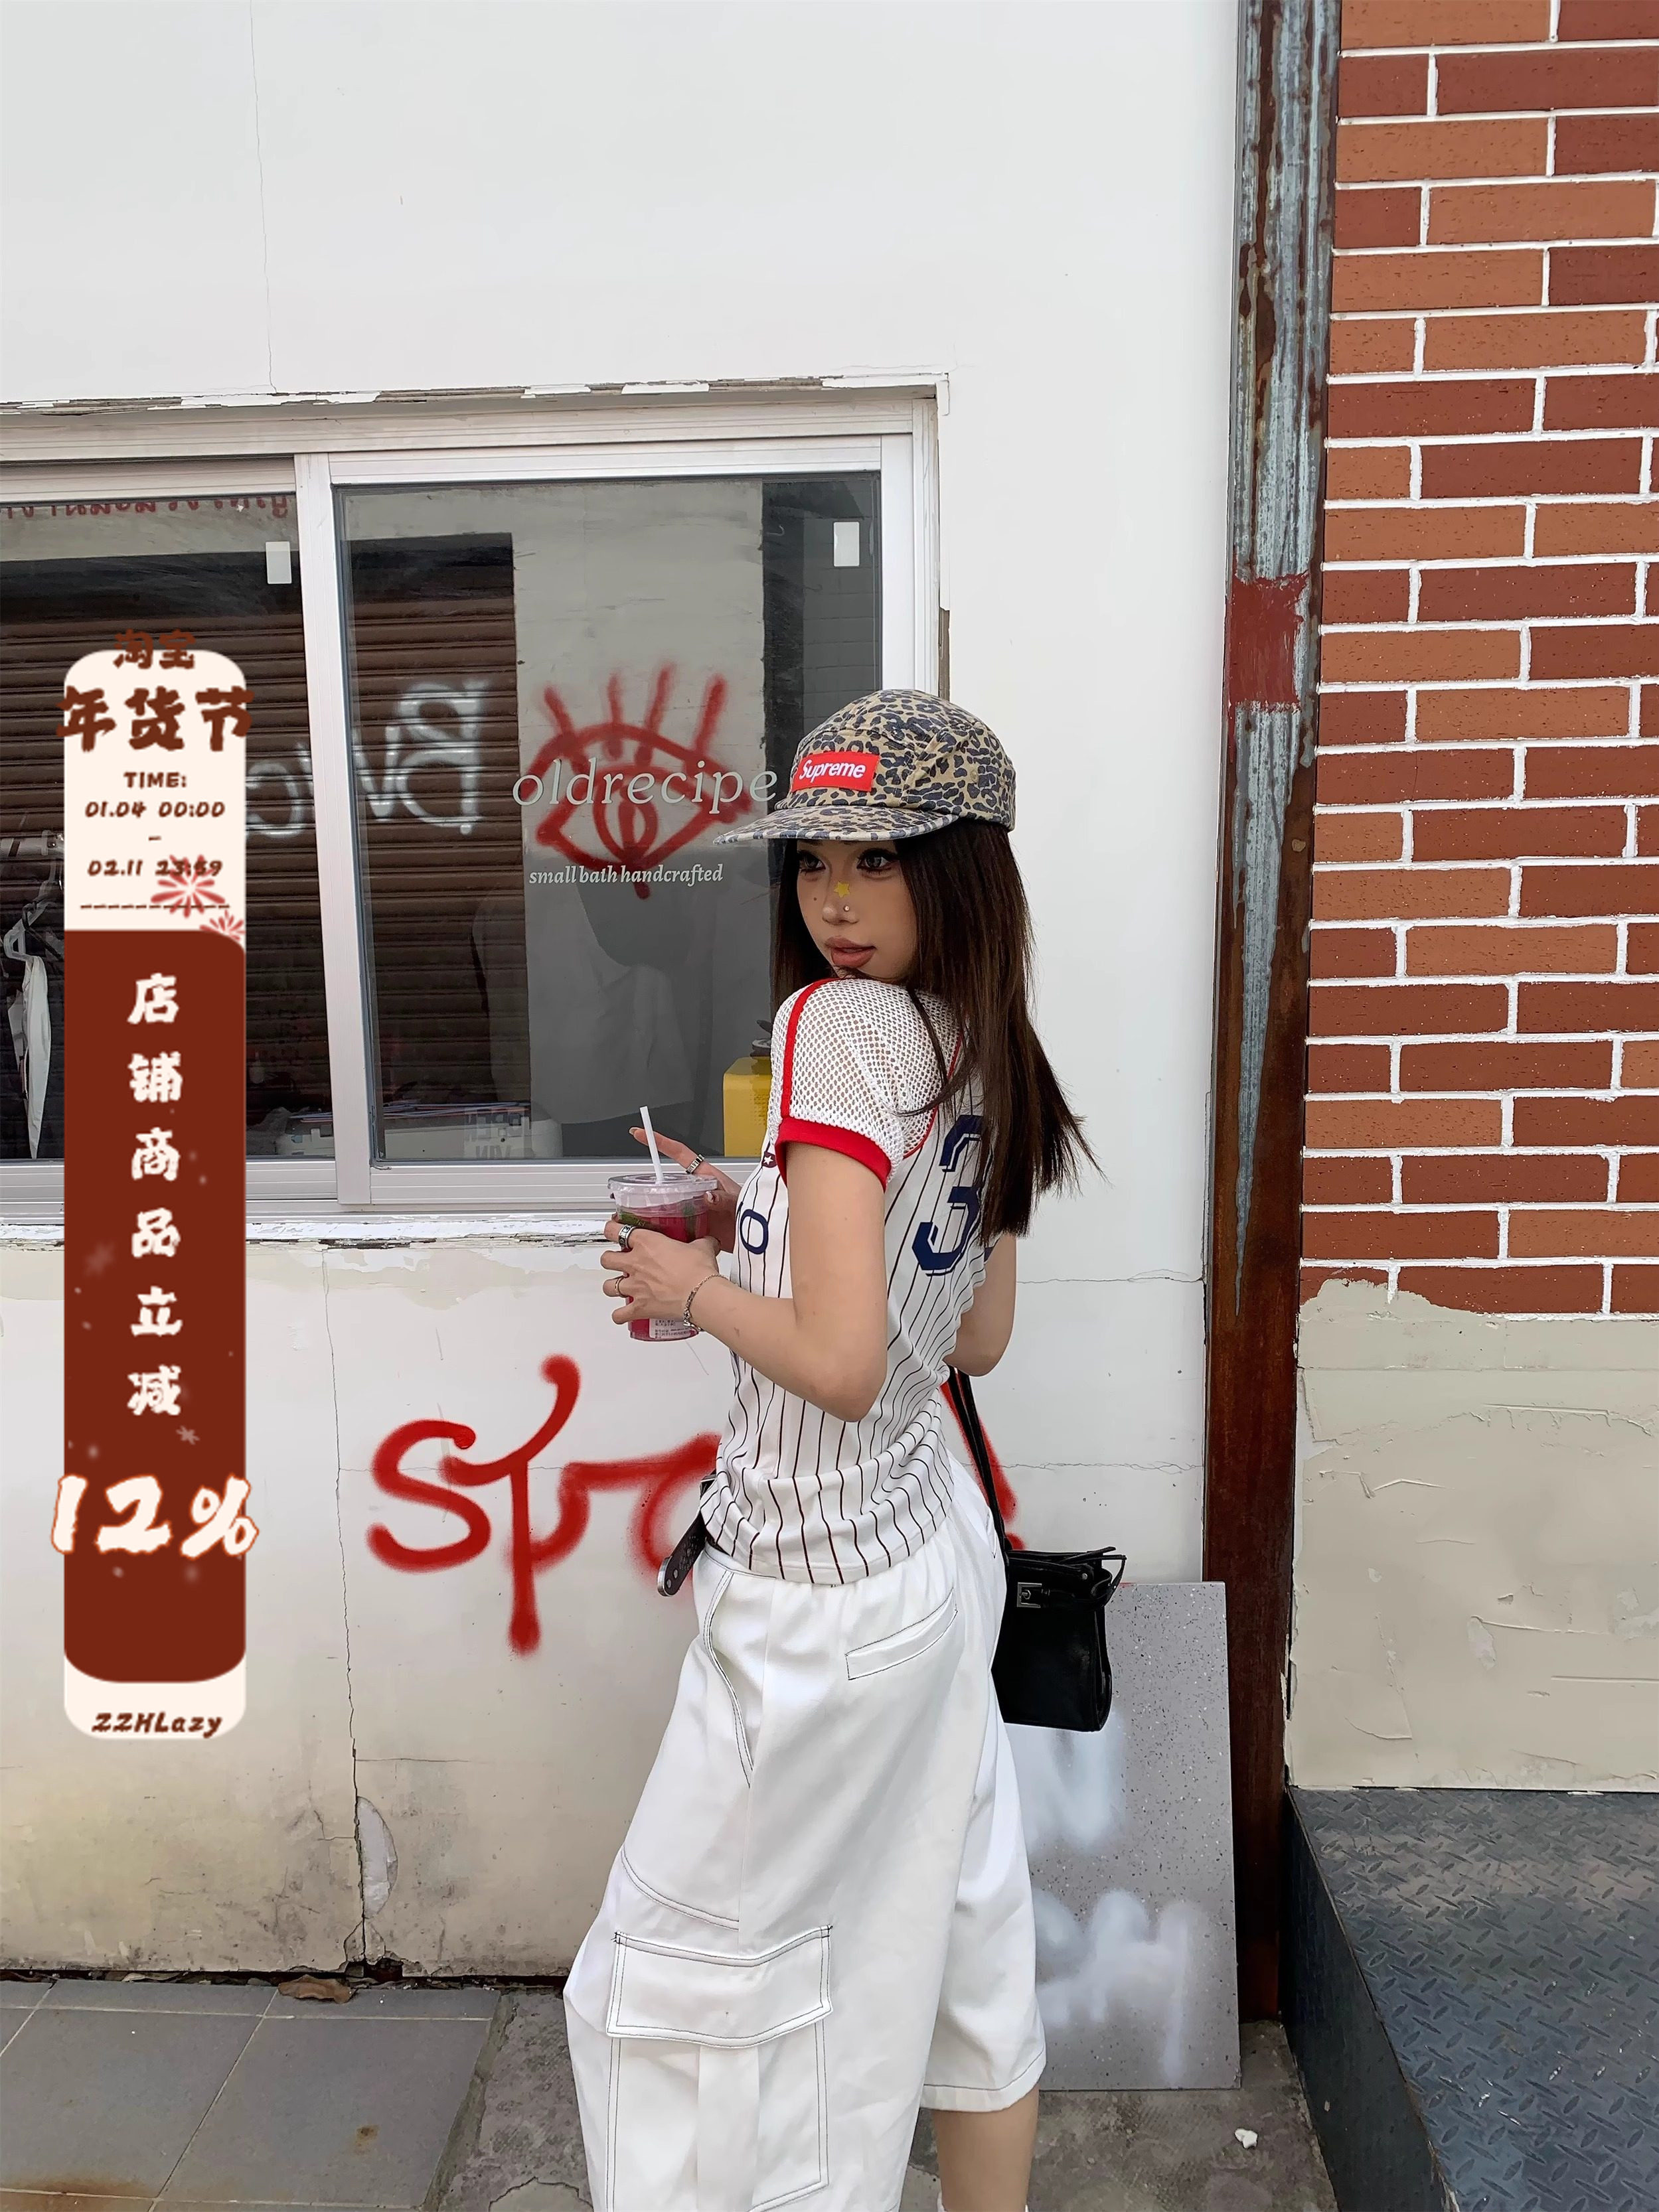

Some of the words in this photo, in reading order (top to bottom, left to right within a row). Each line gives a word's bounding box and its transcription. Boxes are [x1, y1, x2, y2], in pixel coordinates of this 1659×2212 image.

[513, 757, 778, 814] oldrecipe
[799, 759, 866, 783] Supreme
[529, 865, 576, 885] small
[579, 865, 618, 884] bath
[620, 863, 724, 887] handcrafted
[912, 1114, 993, 1277] 3
